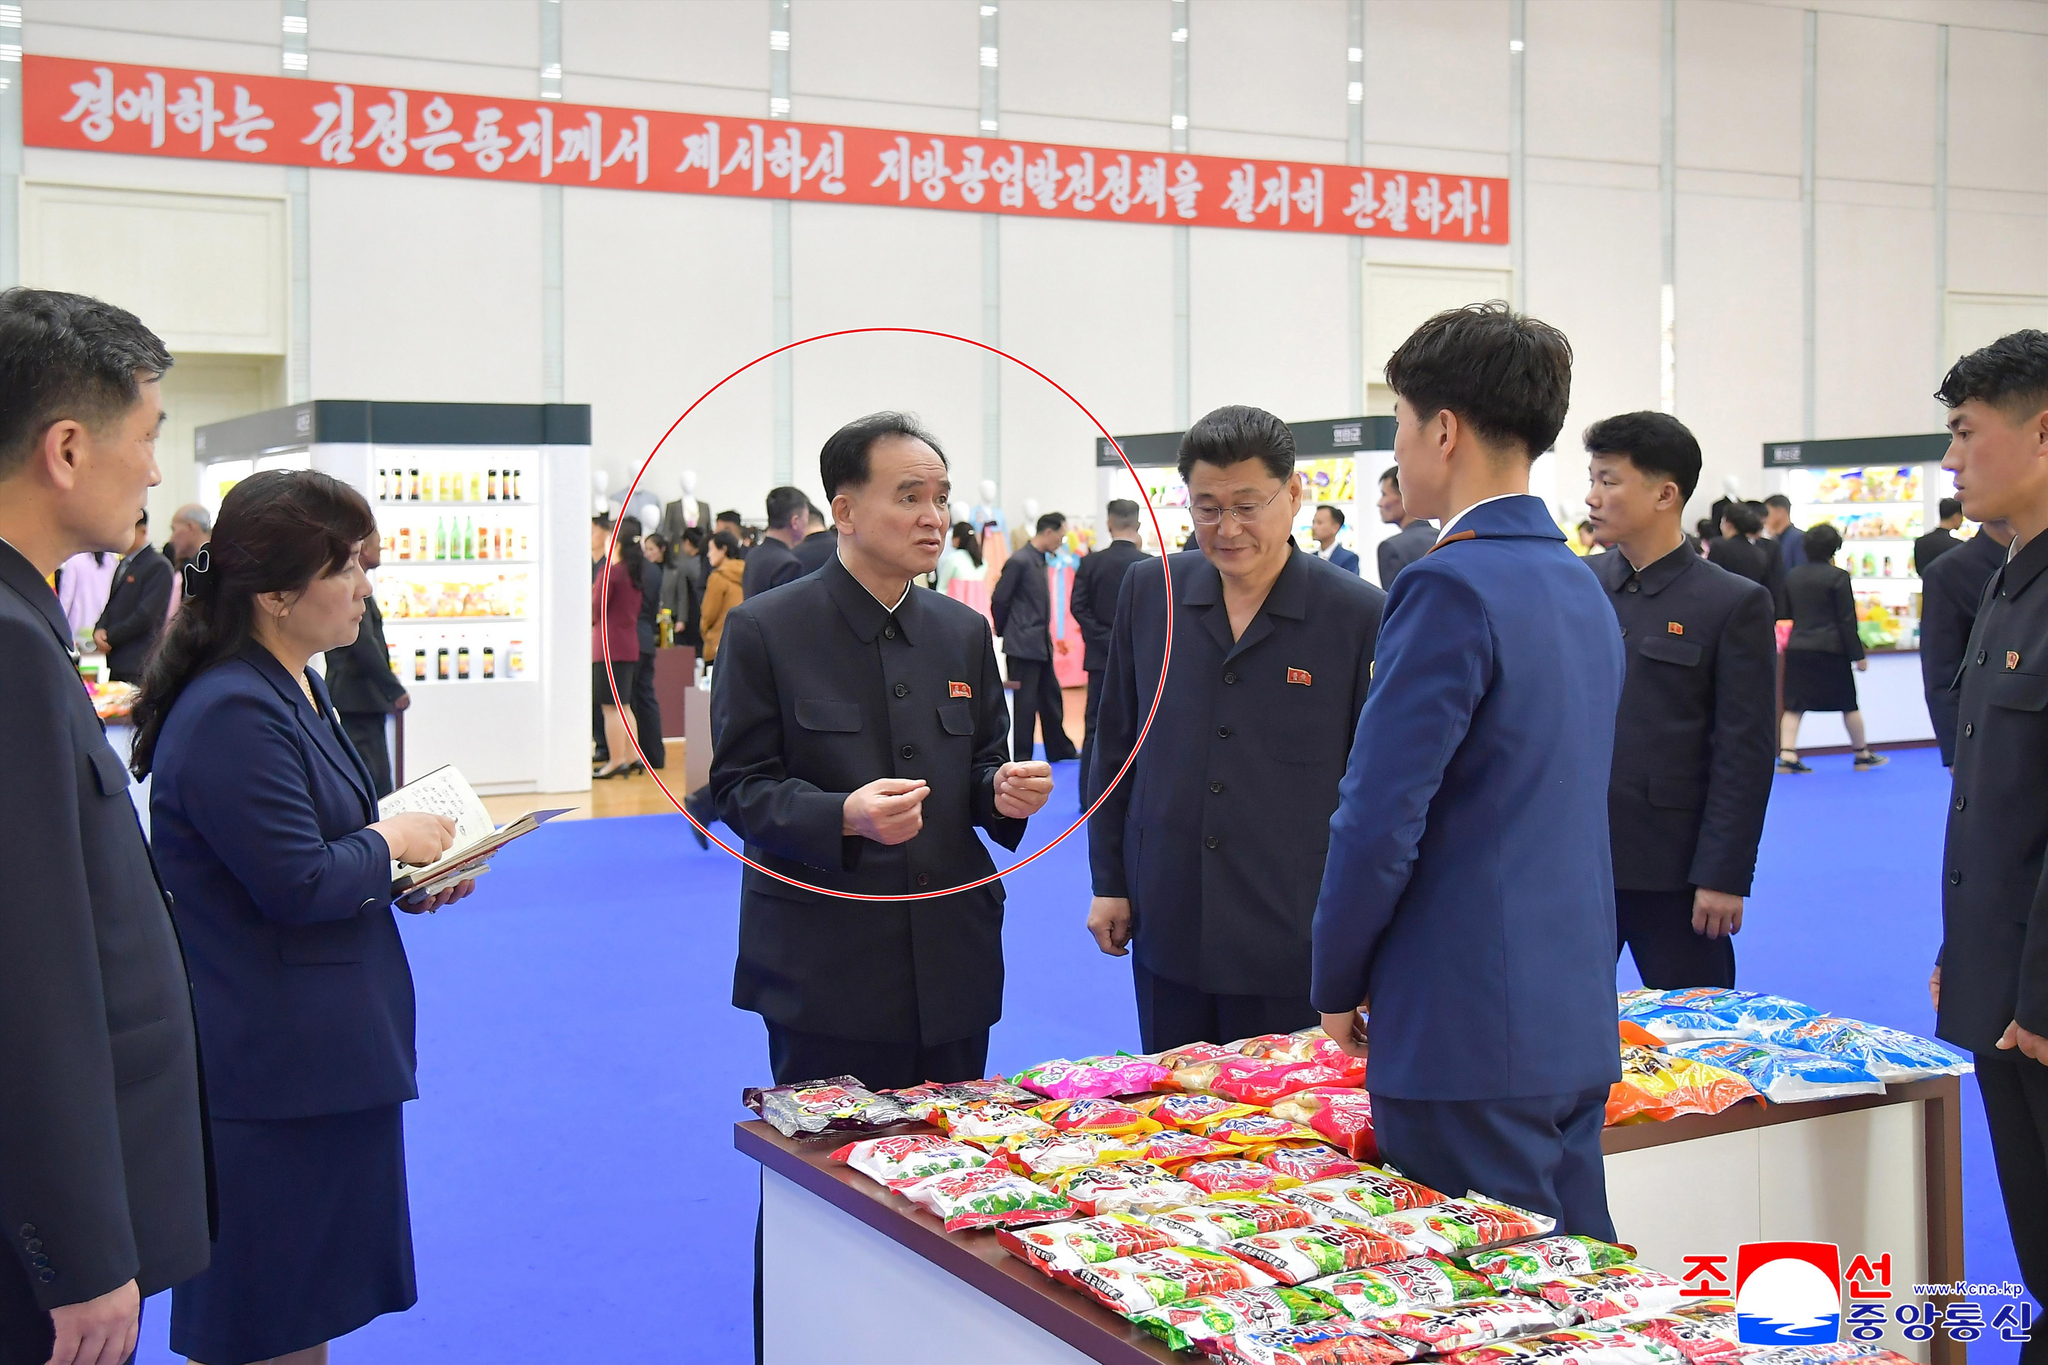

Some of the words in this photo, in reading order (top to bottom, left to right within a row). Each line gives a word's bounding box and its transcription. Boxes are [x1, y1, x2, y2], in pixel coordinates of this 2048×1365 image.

[61, 67, 275, 153] 경애하는
[301, 85, 650, 185] 김정은동지께서
[675, 121, 847, 198] 제시하신
[870, 136, 1203, 221] 지방공업발전정책을
[1221, 163, 1324, 227] 철저히
[1342, 172, 1490, 236] 관철하자!
